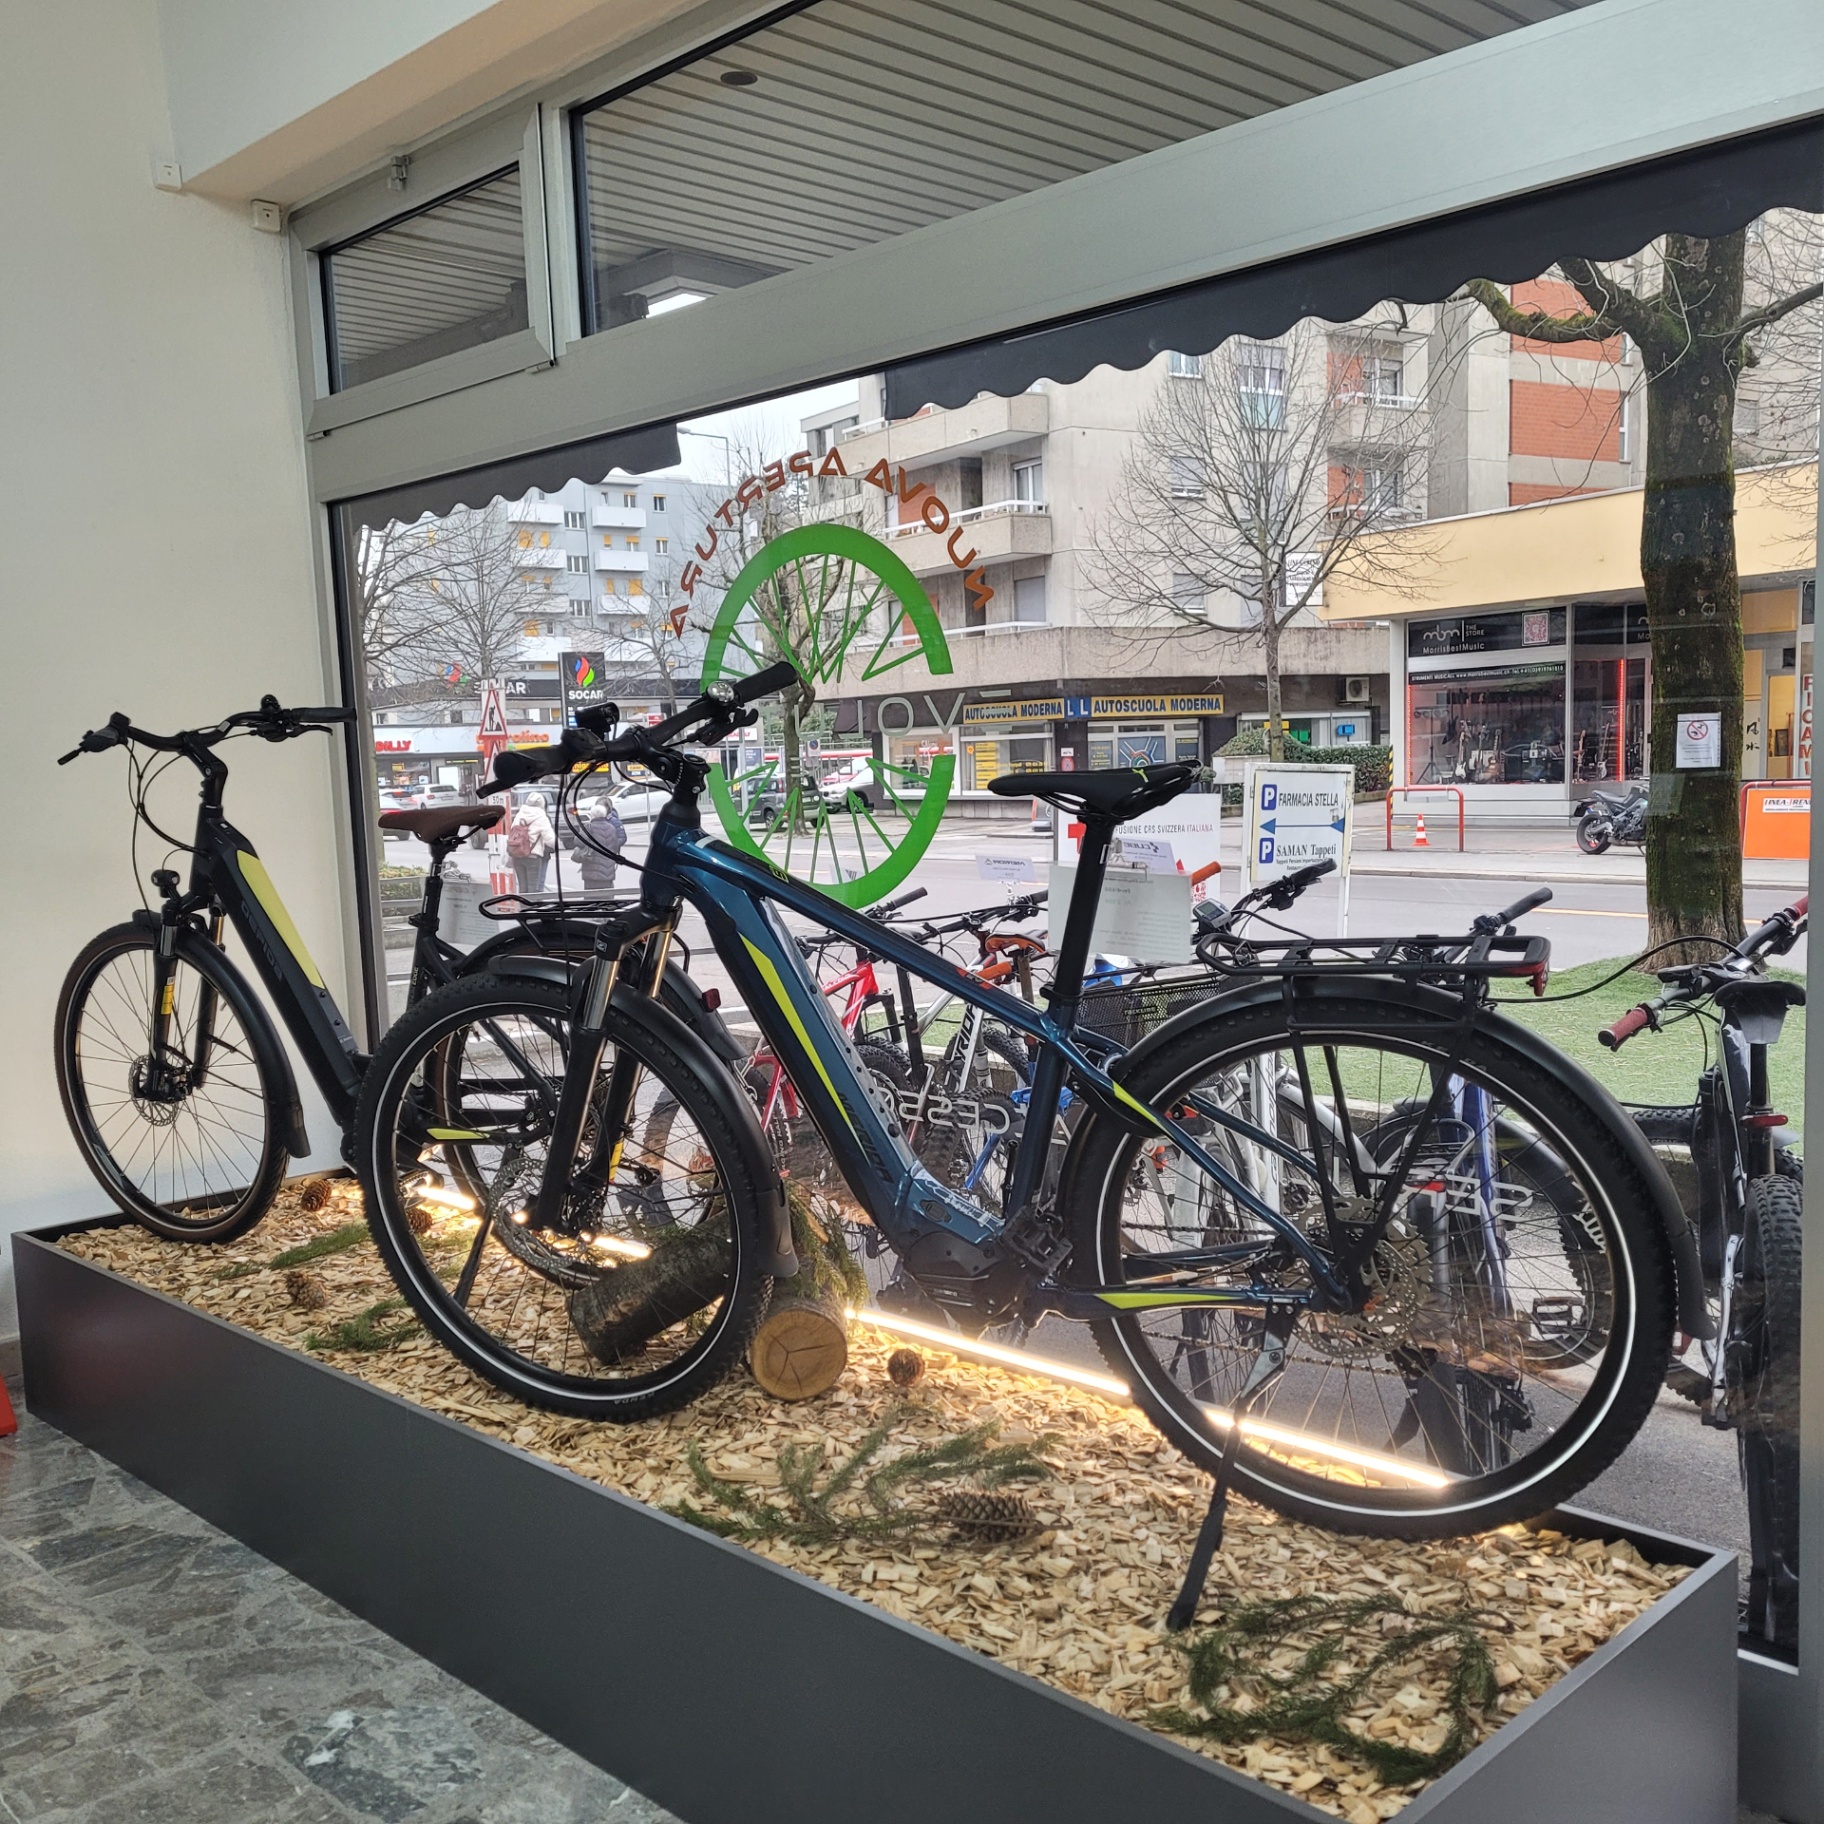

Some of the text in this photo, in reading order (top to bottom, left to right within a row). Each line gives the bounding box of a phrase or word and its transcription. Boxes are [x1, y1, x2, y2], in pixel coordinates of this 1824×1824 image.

[1465, 628, 1485, 637] STORE
[1422, 641, 1485, 655] MorrisBestMusic
[568, 689, 604, 701] SOCAR
[1020, 700, 1063, 717] MODERNA
[1093, 696, 1221, 714] AUTOSCUOLA MODERNA
[375, 740, 412, 752] DILLY
[1278, 792, 1339, 807] FARMACIA STELLA
[1114, 825, 1142, 835] FUSIONE
[1157, 825, 1186, 834] SVIZZERA
[1186, 824, 1213, 833] ITALIANA
[1276, 843, 1337, 859] SAMAN Tappeti
